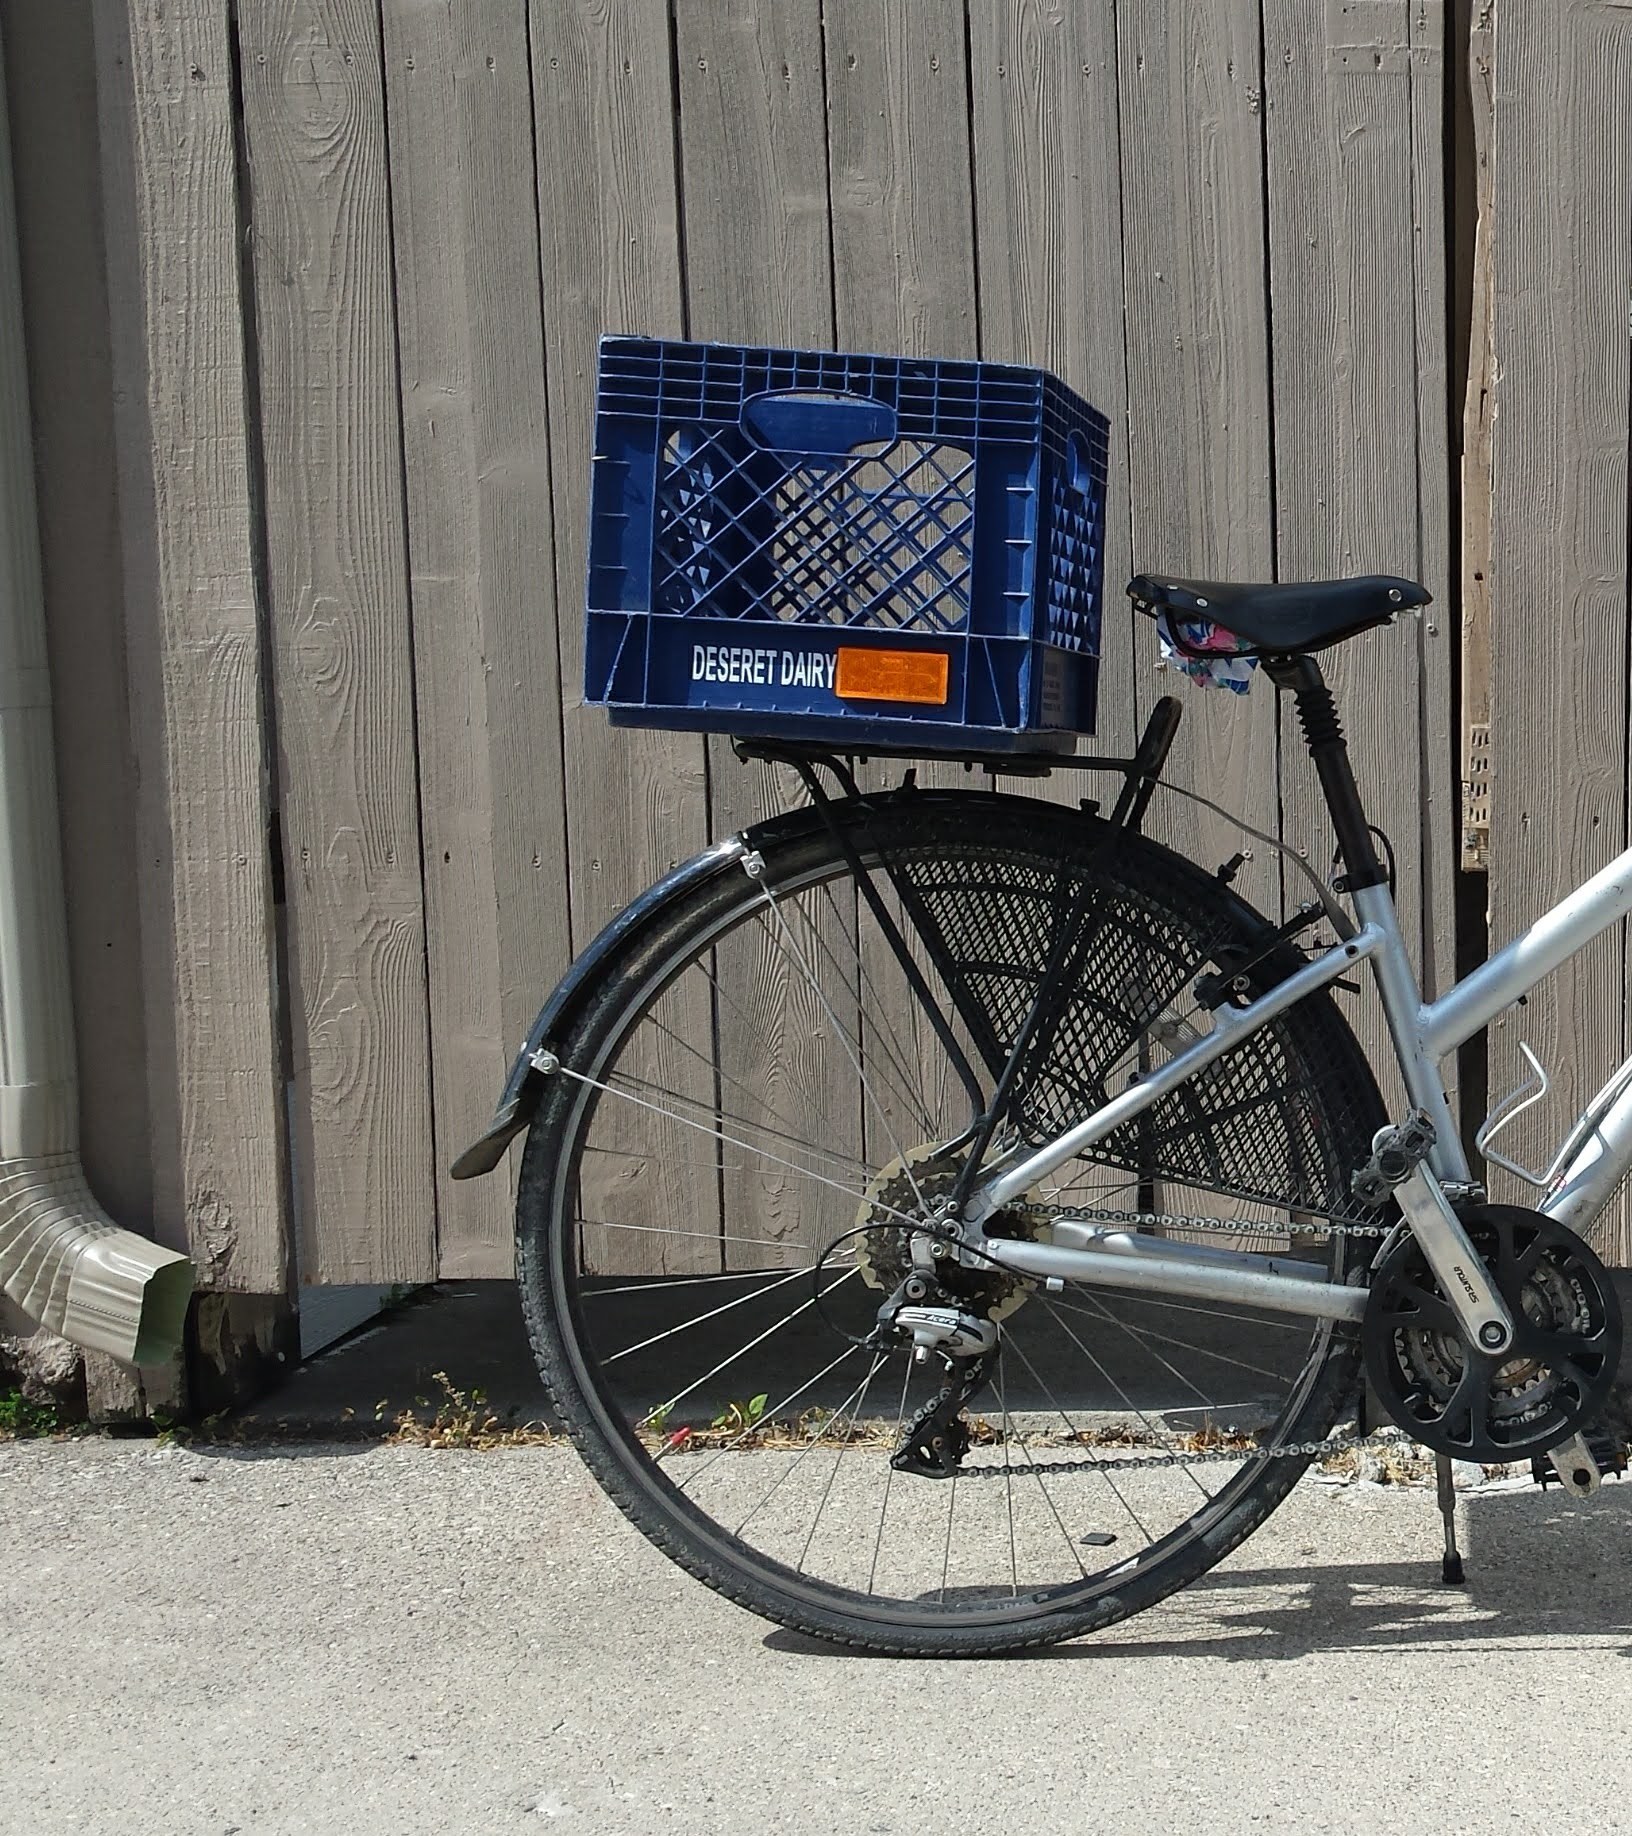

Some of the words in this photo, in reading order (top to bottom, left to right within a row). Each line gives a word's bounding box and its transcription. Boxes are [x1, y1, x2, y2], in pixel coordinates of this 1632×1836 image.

[692, 645, 777, 684] DESERET
[781, 651, 837, 688] DAIRY
[1453, 1266, 1474, 1293] SUNTOUR
[927, 1314, 957, 1325] Acera
